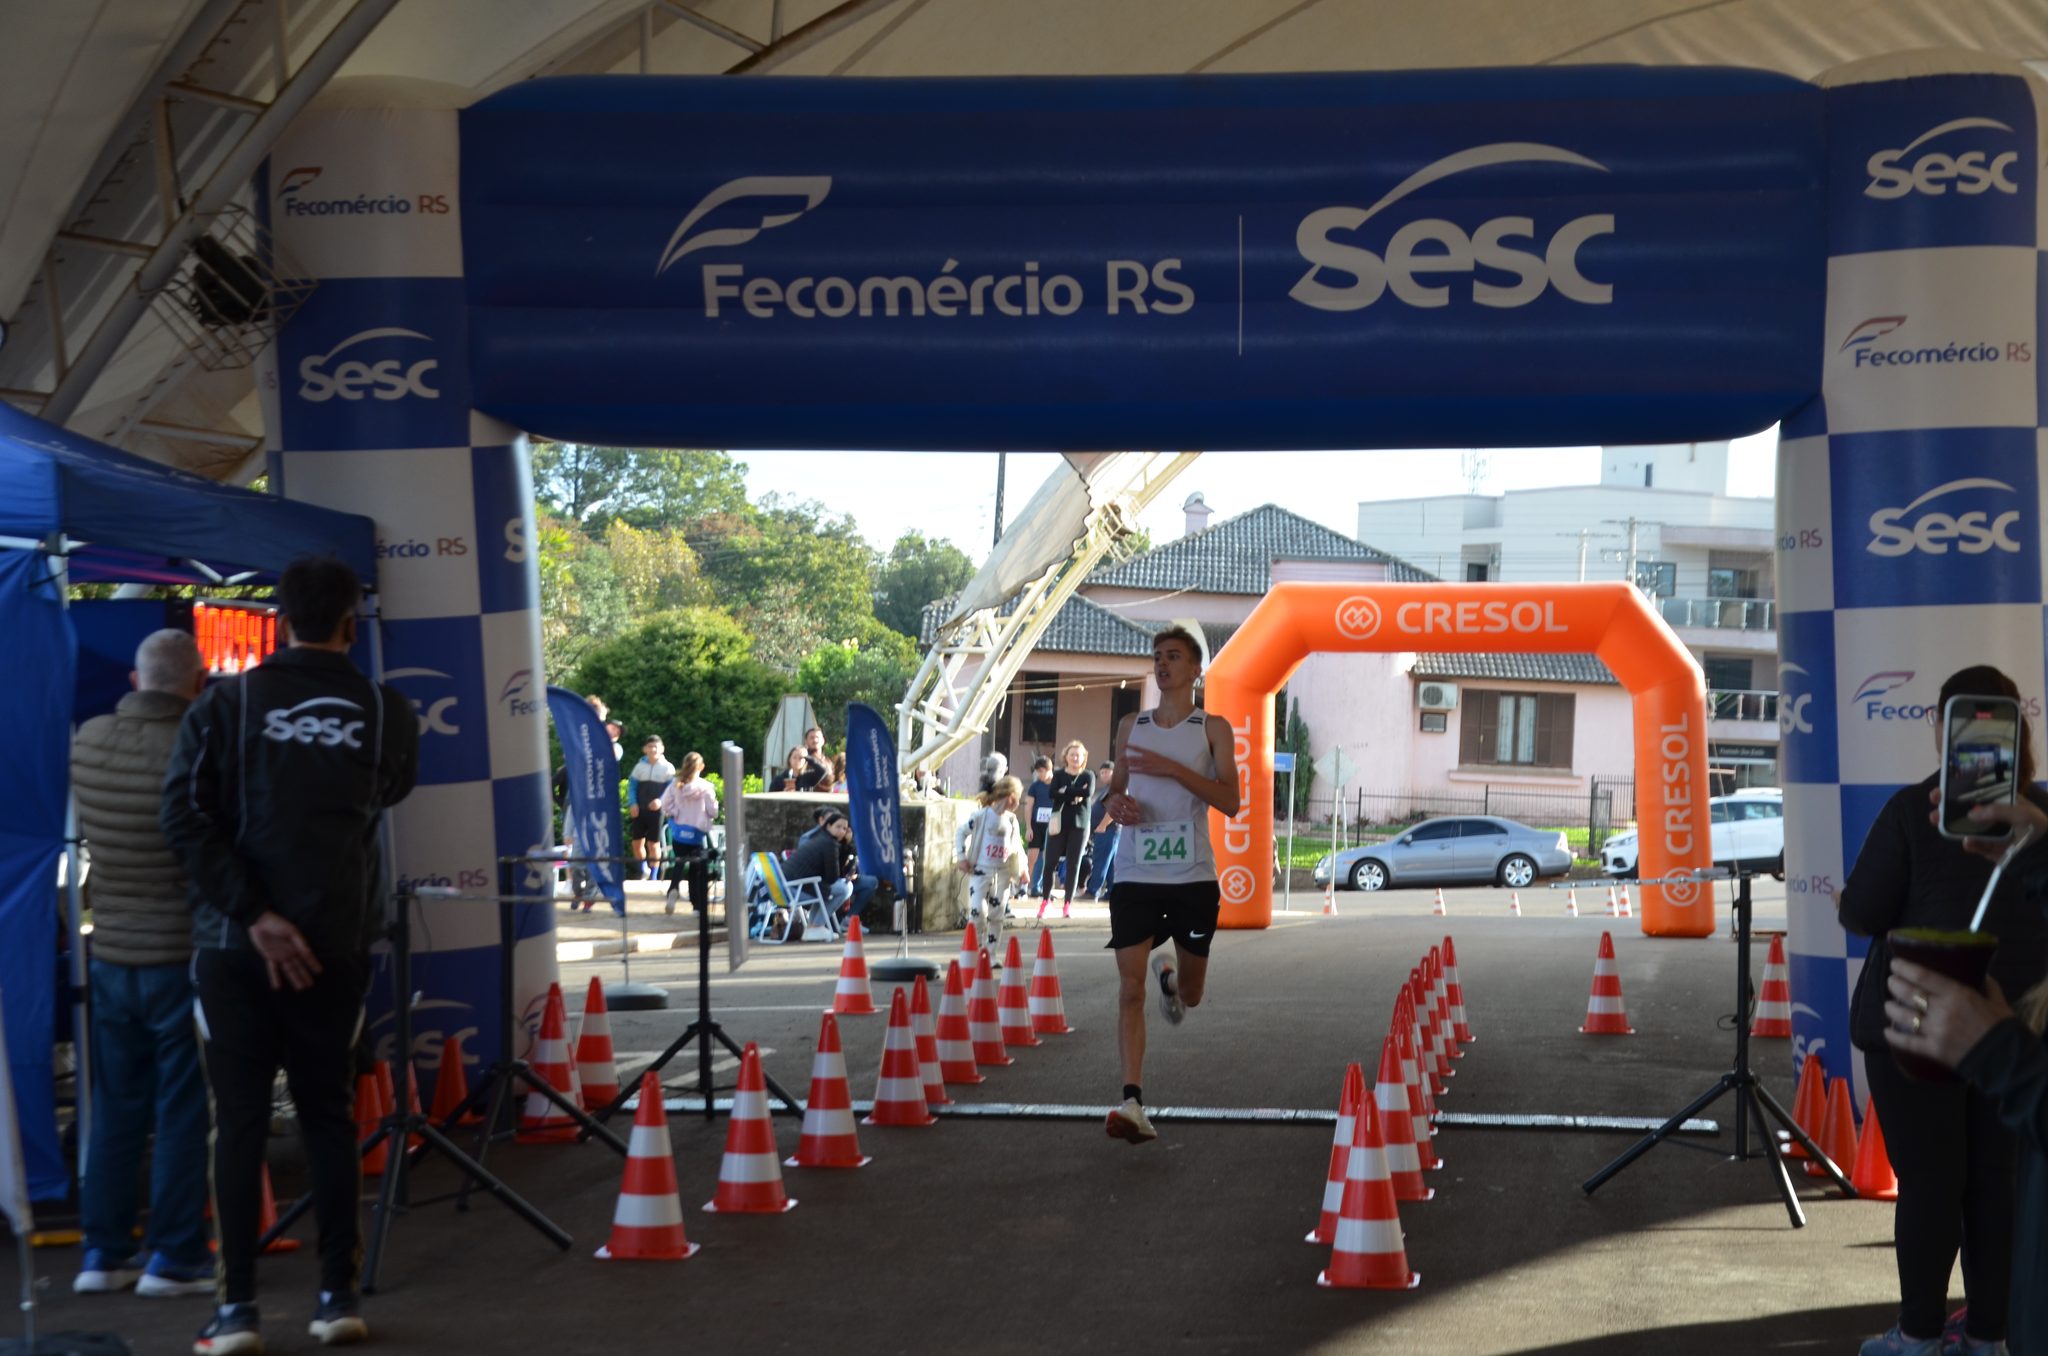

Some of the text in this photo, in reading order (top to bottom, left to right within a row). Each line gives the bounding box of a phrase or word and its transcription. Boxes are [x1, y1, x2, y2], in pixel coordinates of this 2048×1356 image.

[285, 194, 450, 217] Fecomércio RS
[702, 258, 1195, 318] Fecomércio RS
[1855, 342, 2032, 368] Fecomércio RS
[436, 537, 468, 557] RS
[1396, 600, 1569, 634] CRESOL
[1660, 712, 1694, 855] CRESOL
[1143, 836, 1188, 861] 244
[459, 868, 489, 890] RS
